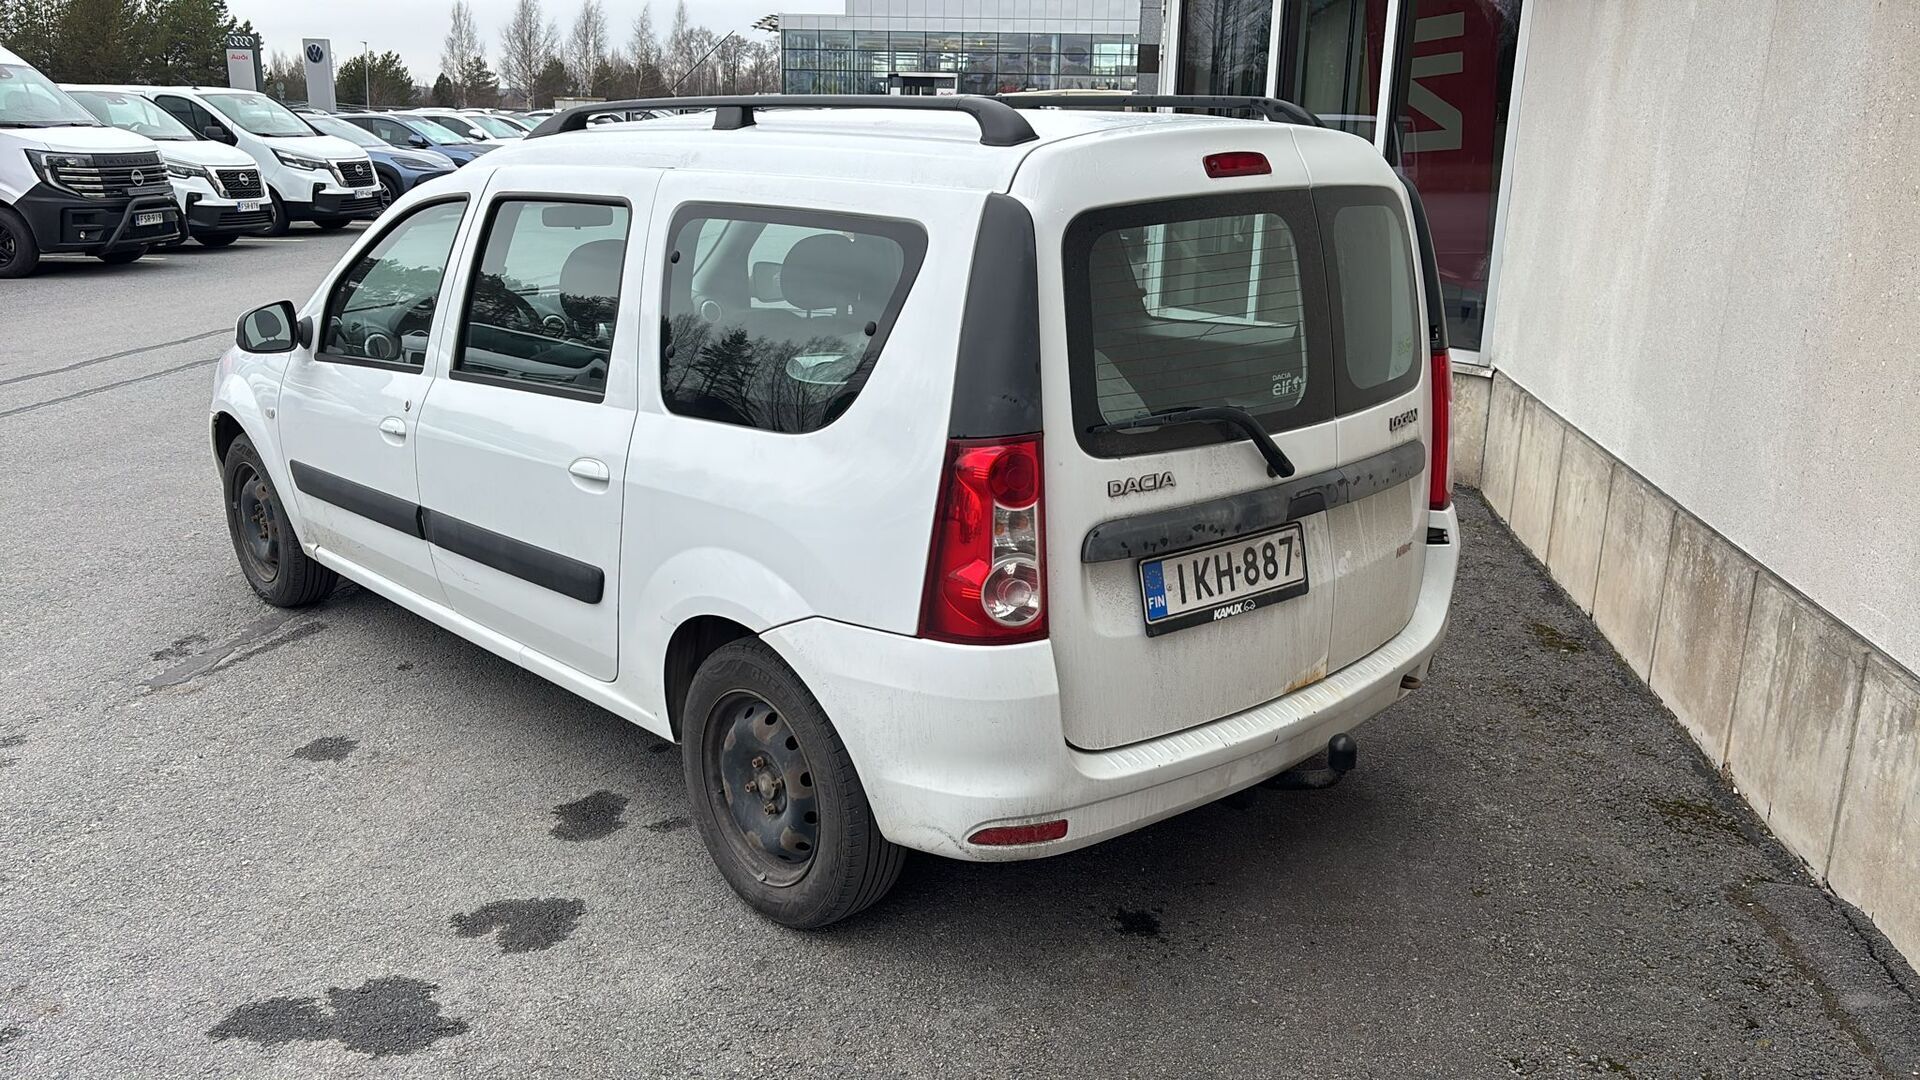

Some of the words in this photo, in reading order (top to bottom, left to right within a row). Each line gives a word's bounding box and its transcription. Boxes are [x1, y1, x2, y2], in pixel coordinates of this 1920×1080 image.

[231, 53, 249, 61] Audi
[139, 213, 162, 224] FSR-919
[1272, 379, 1292, 396] elf
[1389, 408, 1418, 432] LOGAN
[1107, 471, 1177, 498] DACIA
[1177, 535, 1294, 605] IKH-887
[1148, 594, 1166, 610] FIN
[1213, 602, 1243, 621] KAMUX
